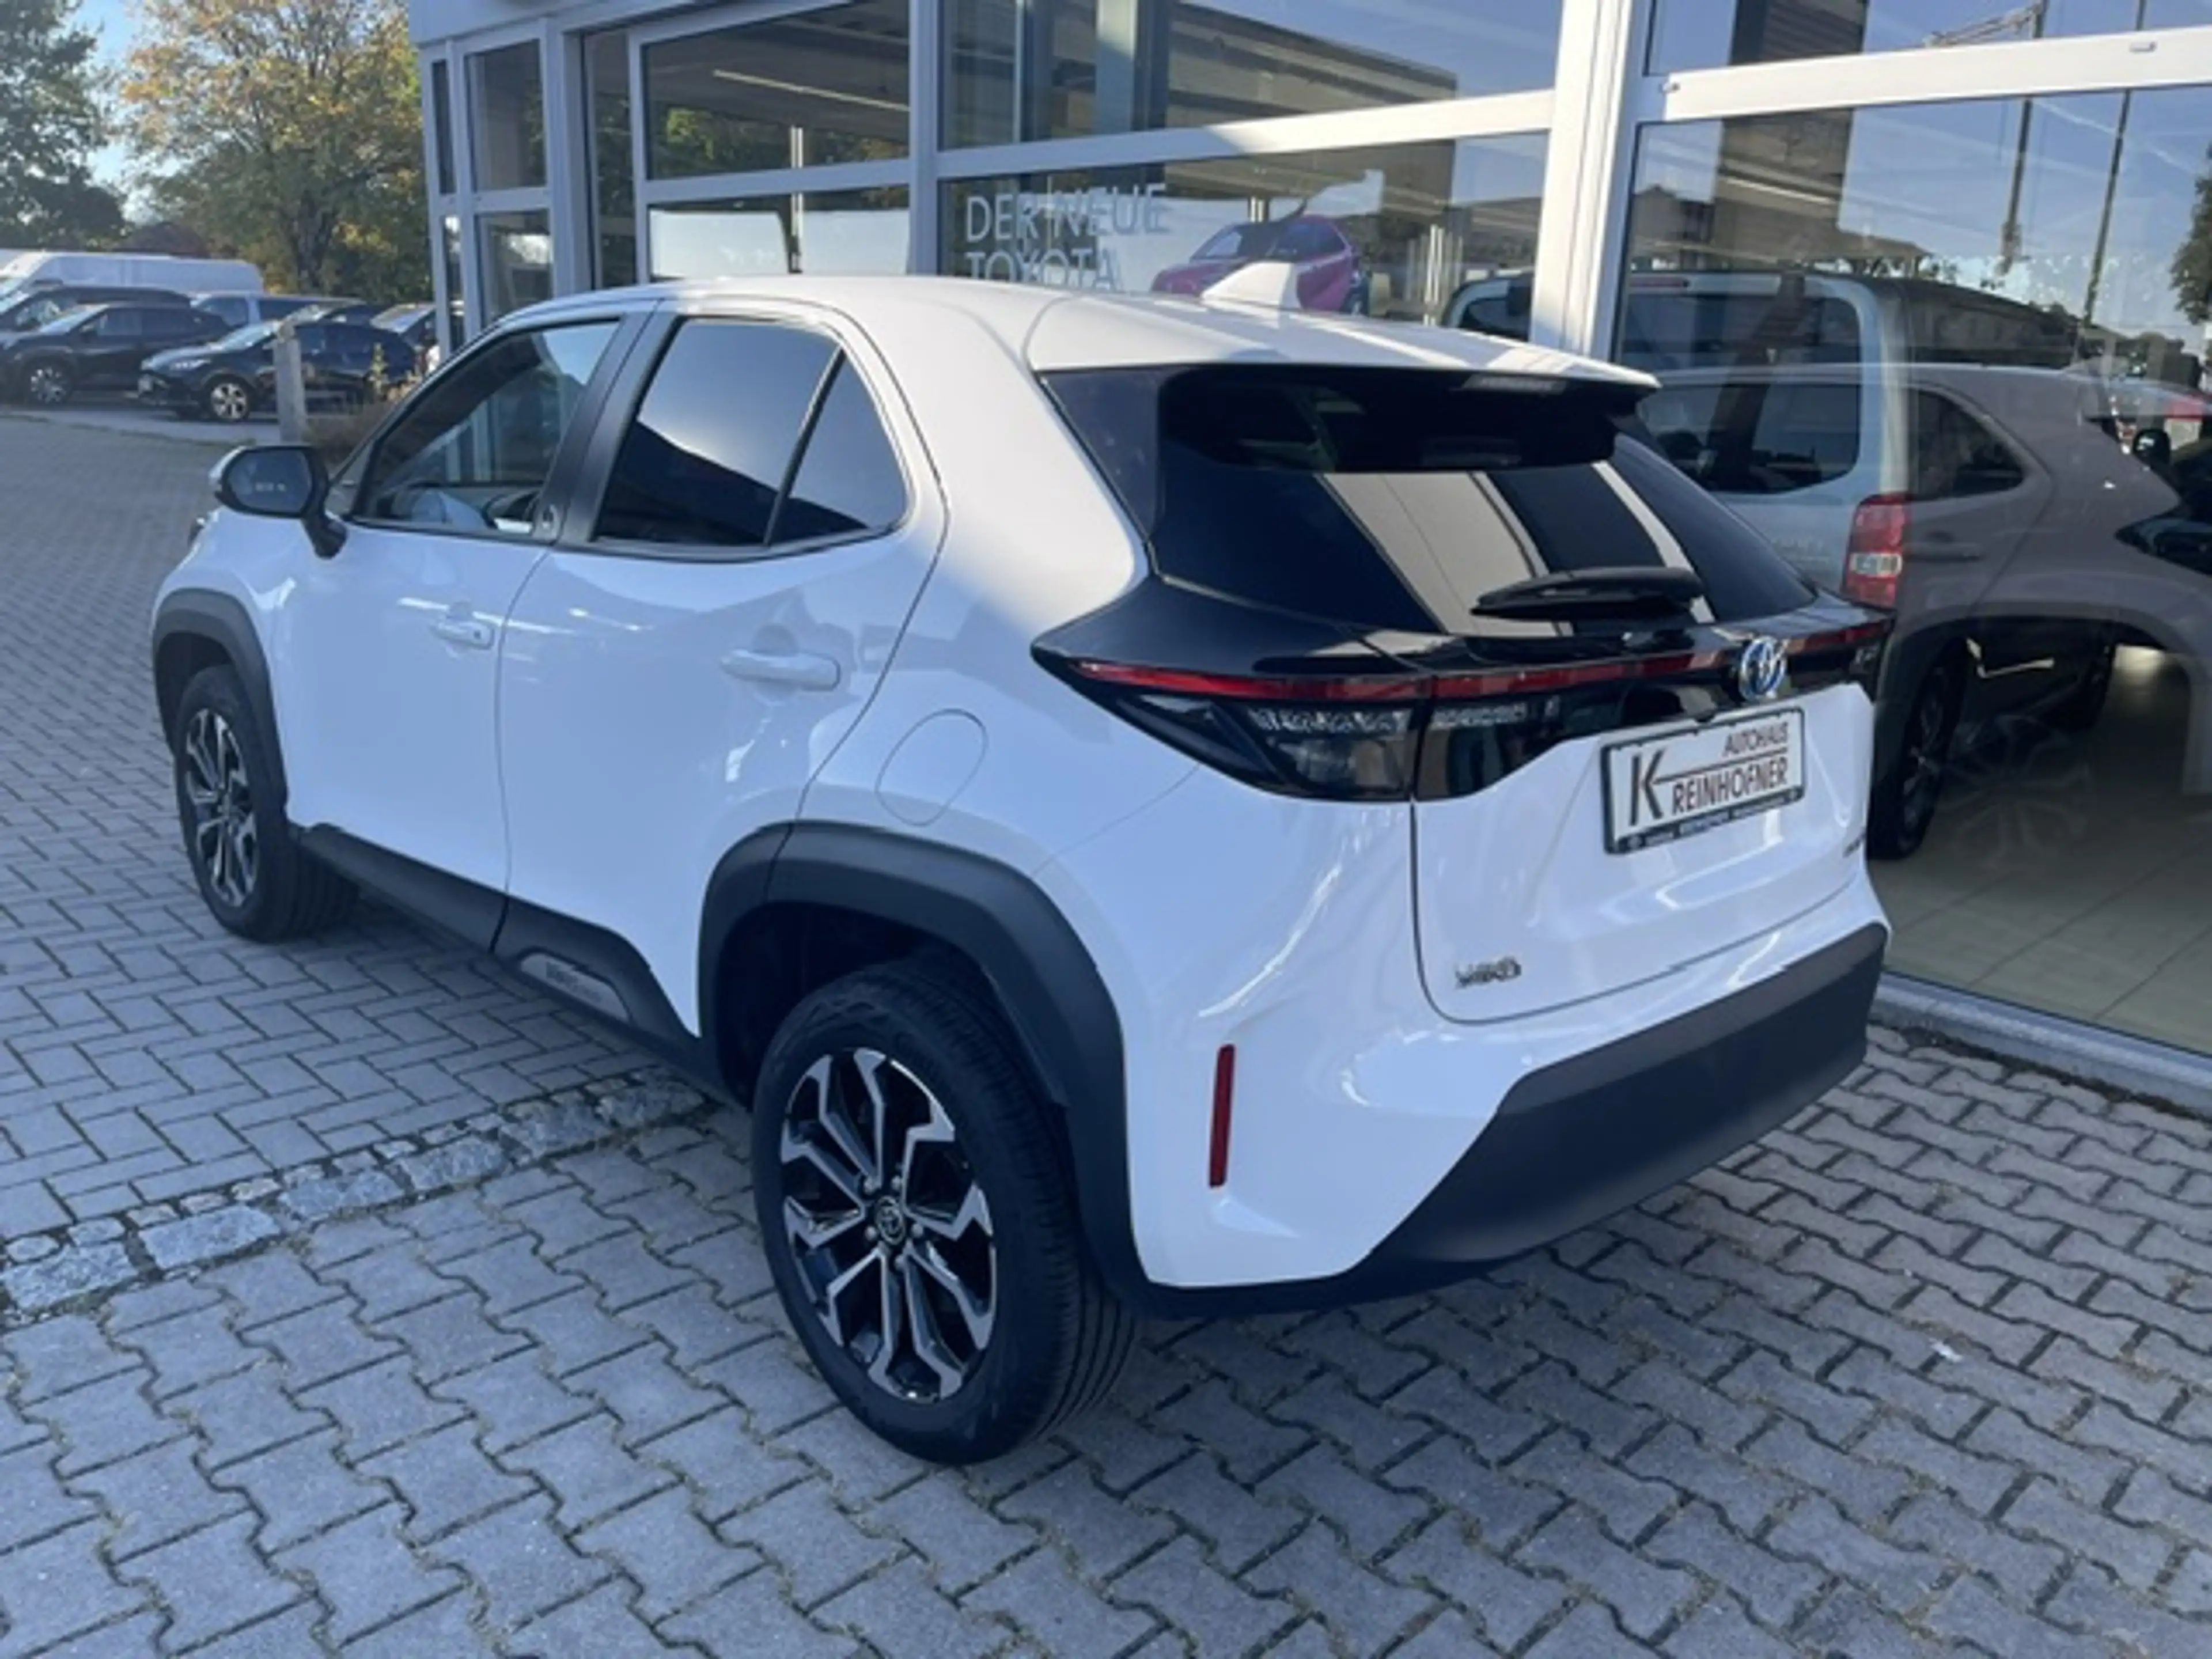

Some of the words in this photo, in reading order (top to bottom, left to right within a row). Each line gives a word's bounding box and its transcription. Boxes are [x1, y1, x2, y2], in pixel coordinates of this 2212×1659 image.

[965, 194, 1039, 242] DER
[1052, 183, 1168, 237] NEUE
[965, 248, 1121, 290] TOYOTA
[1723, 722, 1789, 756] AUTOHAUS
